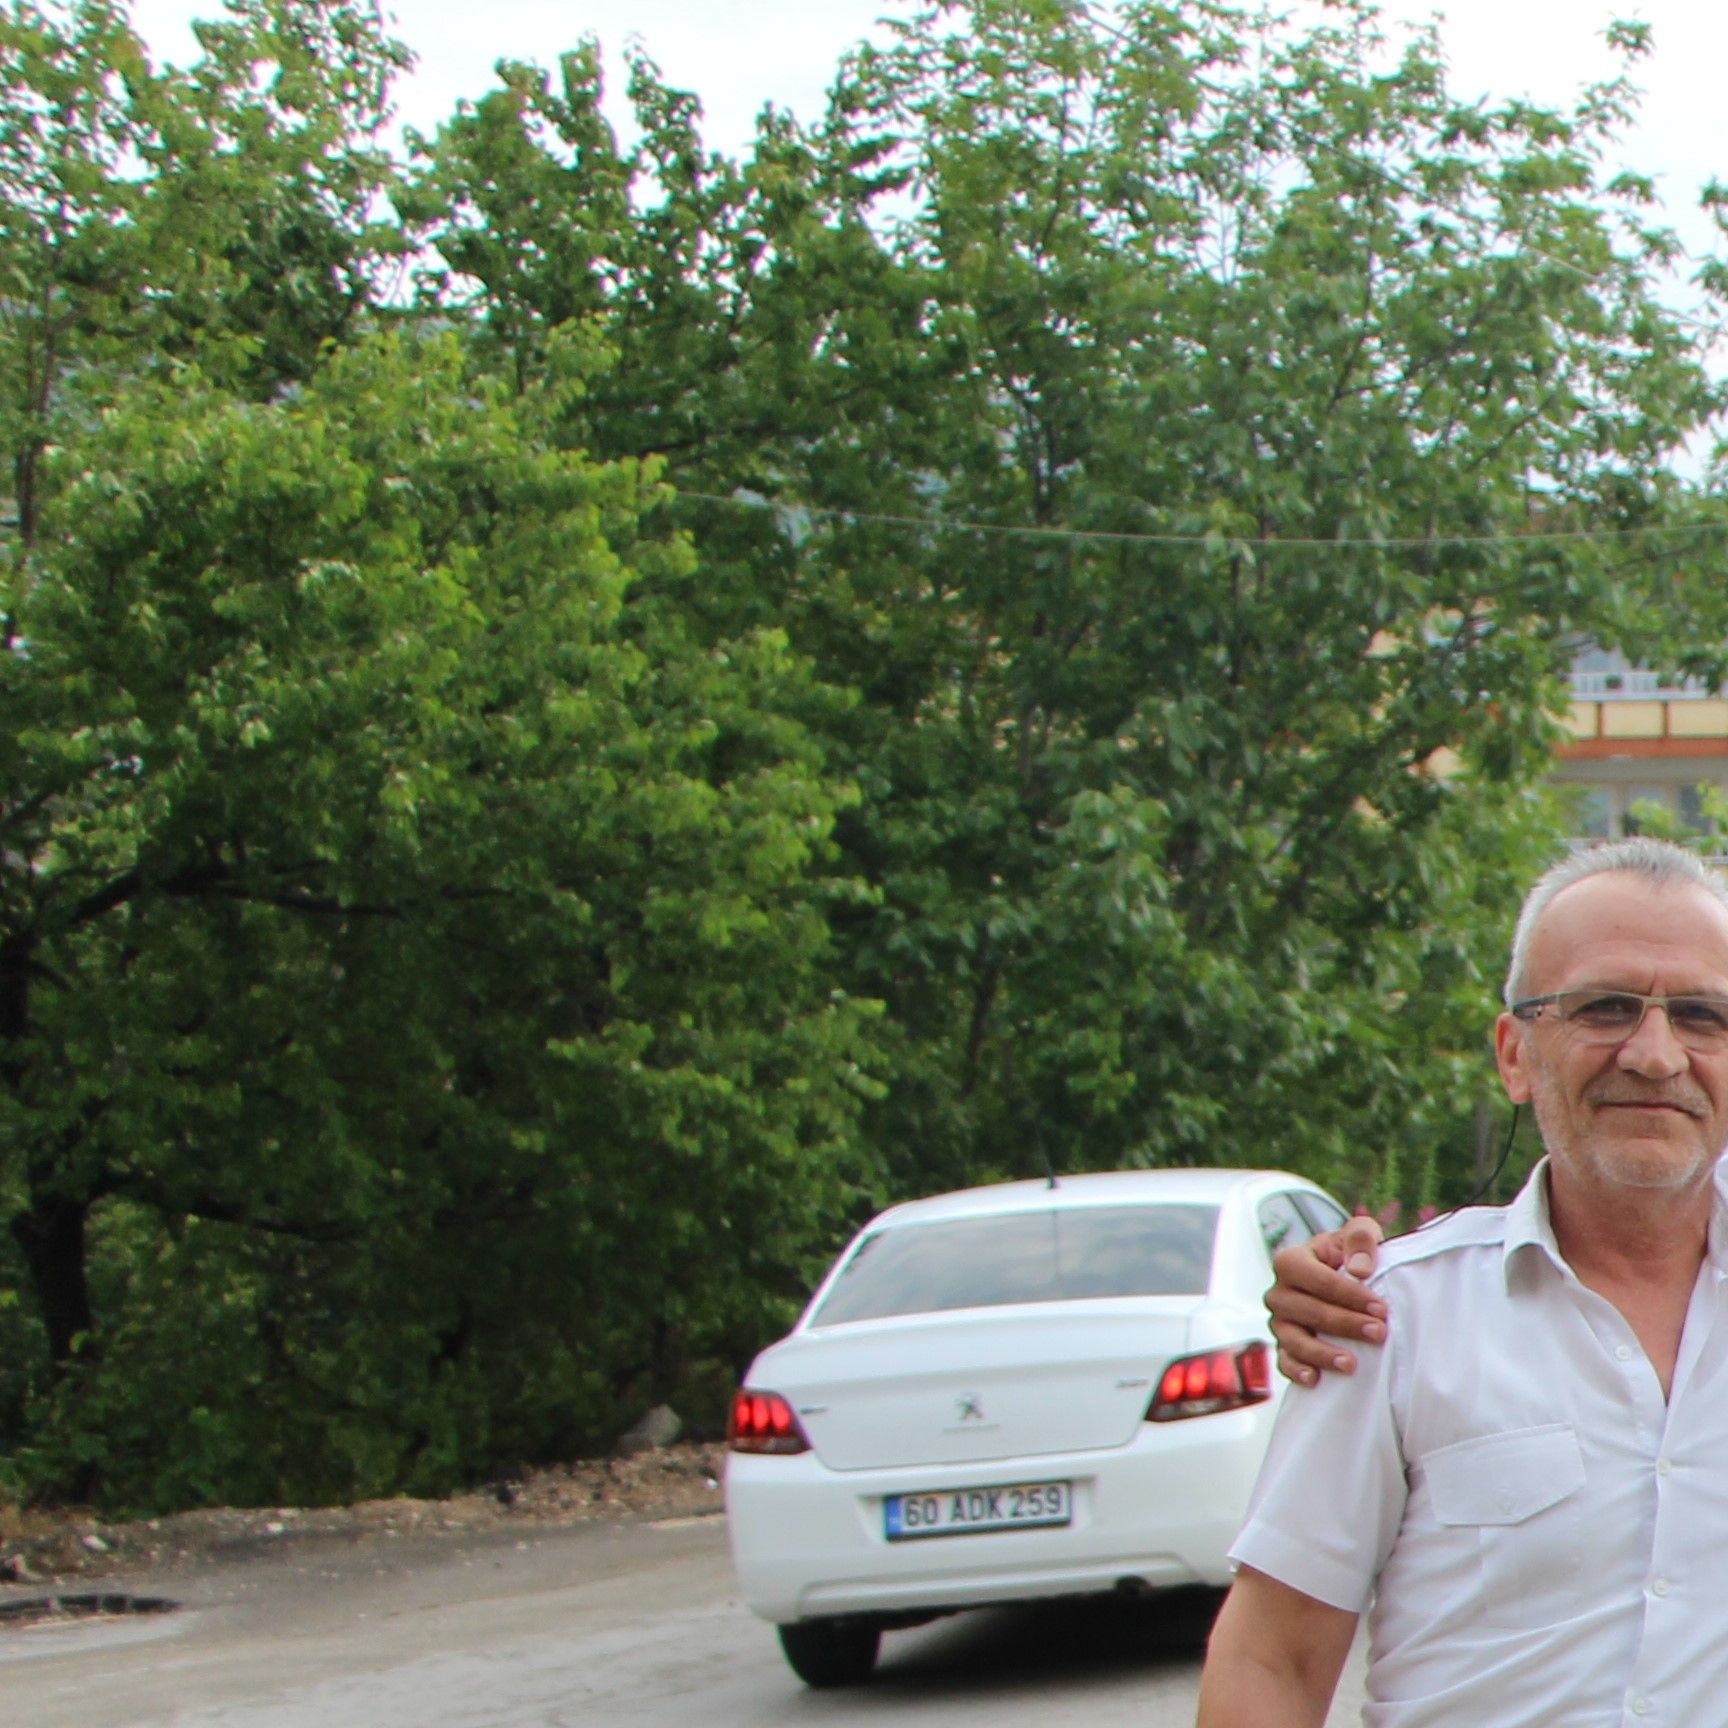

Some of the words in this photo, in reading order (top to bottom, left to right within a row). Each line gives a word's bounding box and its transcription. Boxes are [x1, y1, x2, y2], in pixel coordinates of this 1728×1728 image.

[904, 1497, 938, 1527] 60
[951, 1489, 1002, 1522] ADK
[1008, 1486, 1062, 1518] 259
